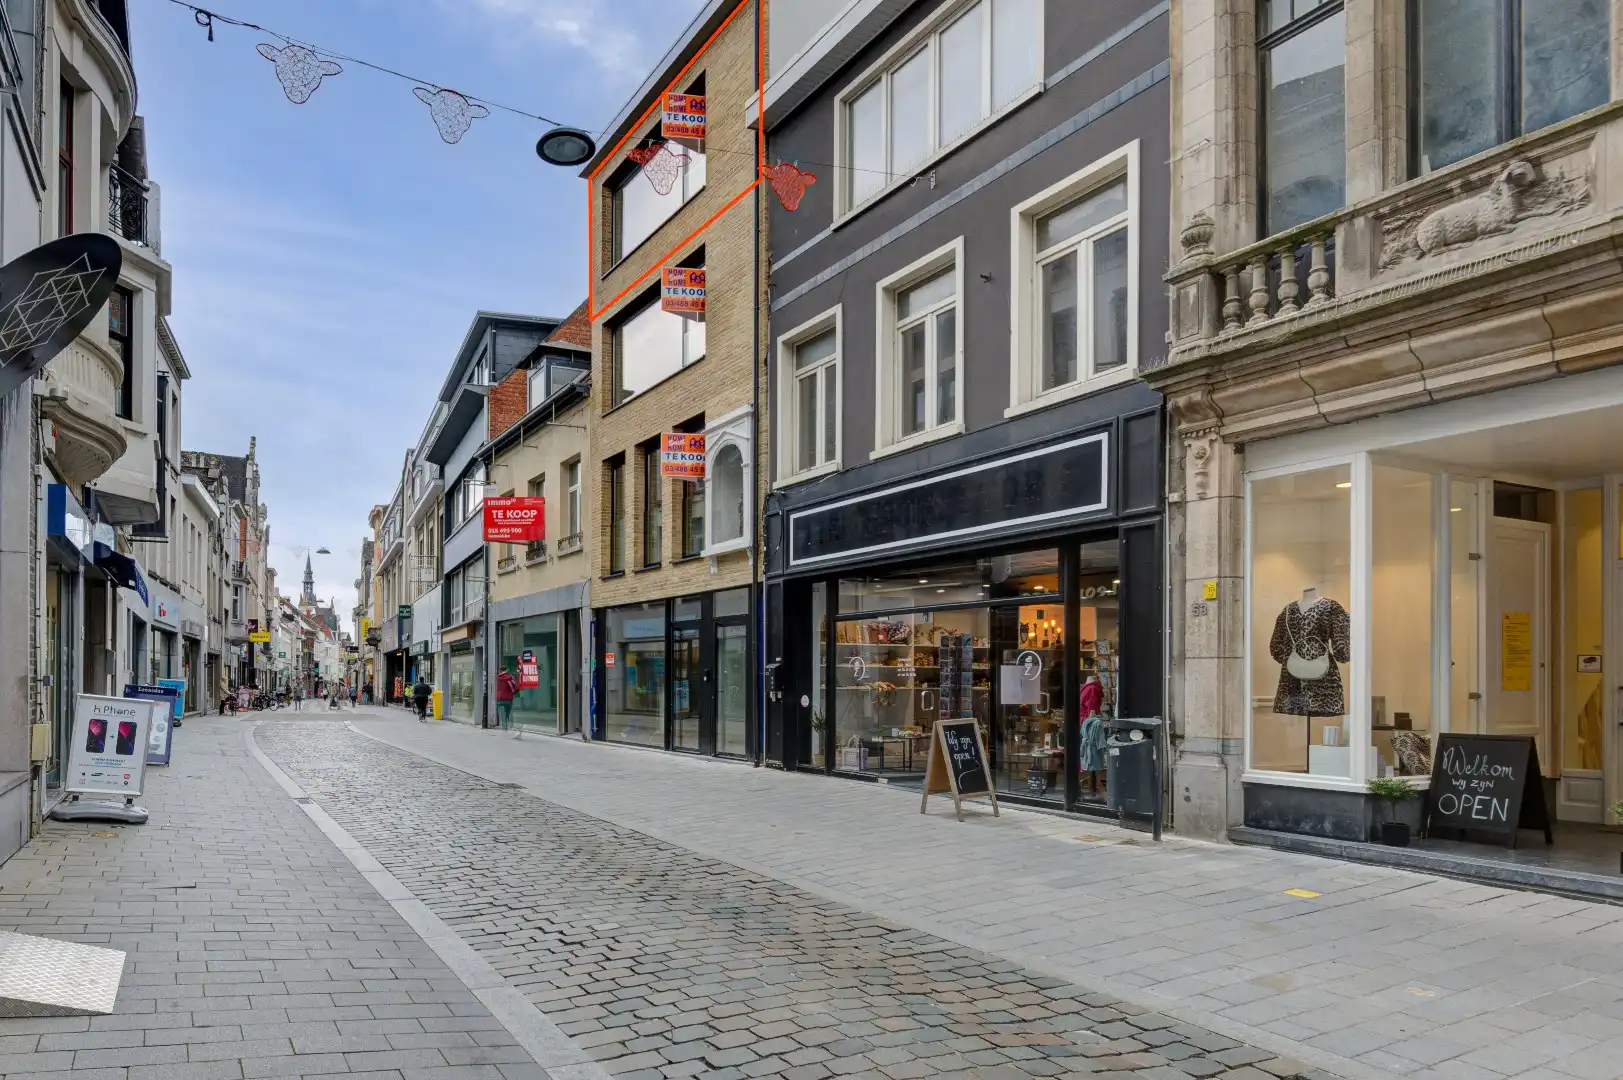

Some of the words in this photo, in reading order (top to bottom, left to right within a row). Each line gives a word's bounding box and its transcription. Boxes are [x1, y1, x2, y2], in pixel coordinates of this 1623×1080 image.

[492, 510, 504, 518] TE
[507, 510, 537, 518] KOOP
[1443, 746, 1515, 780] Welkom
[1439, 794, 1509, 821] OPEN
